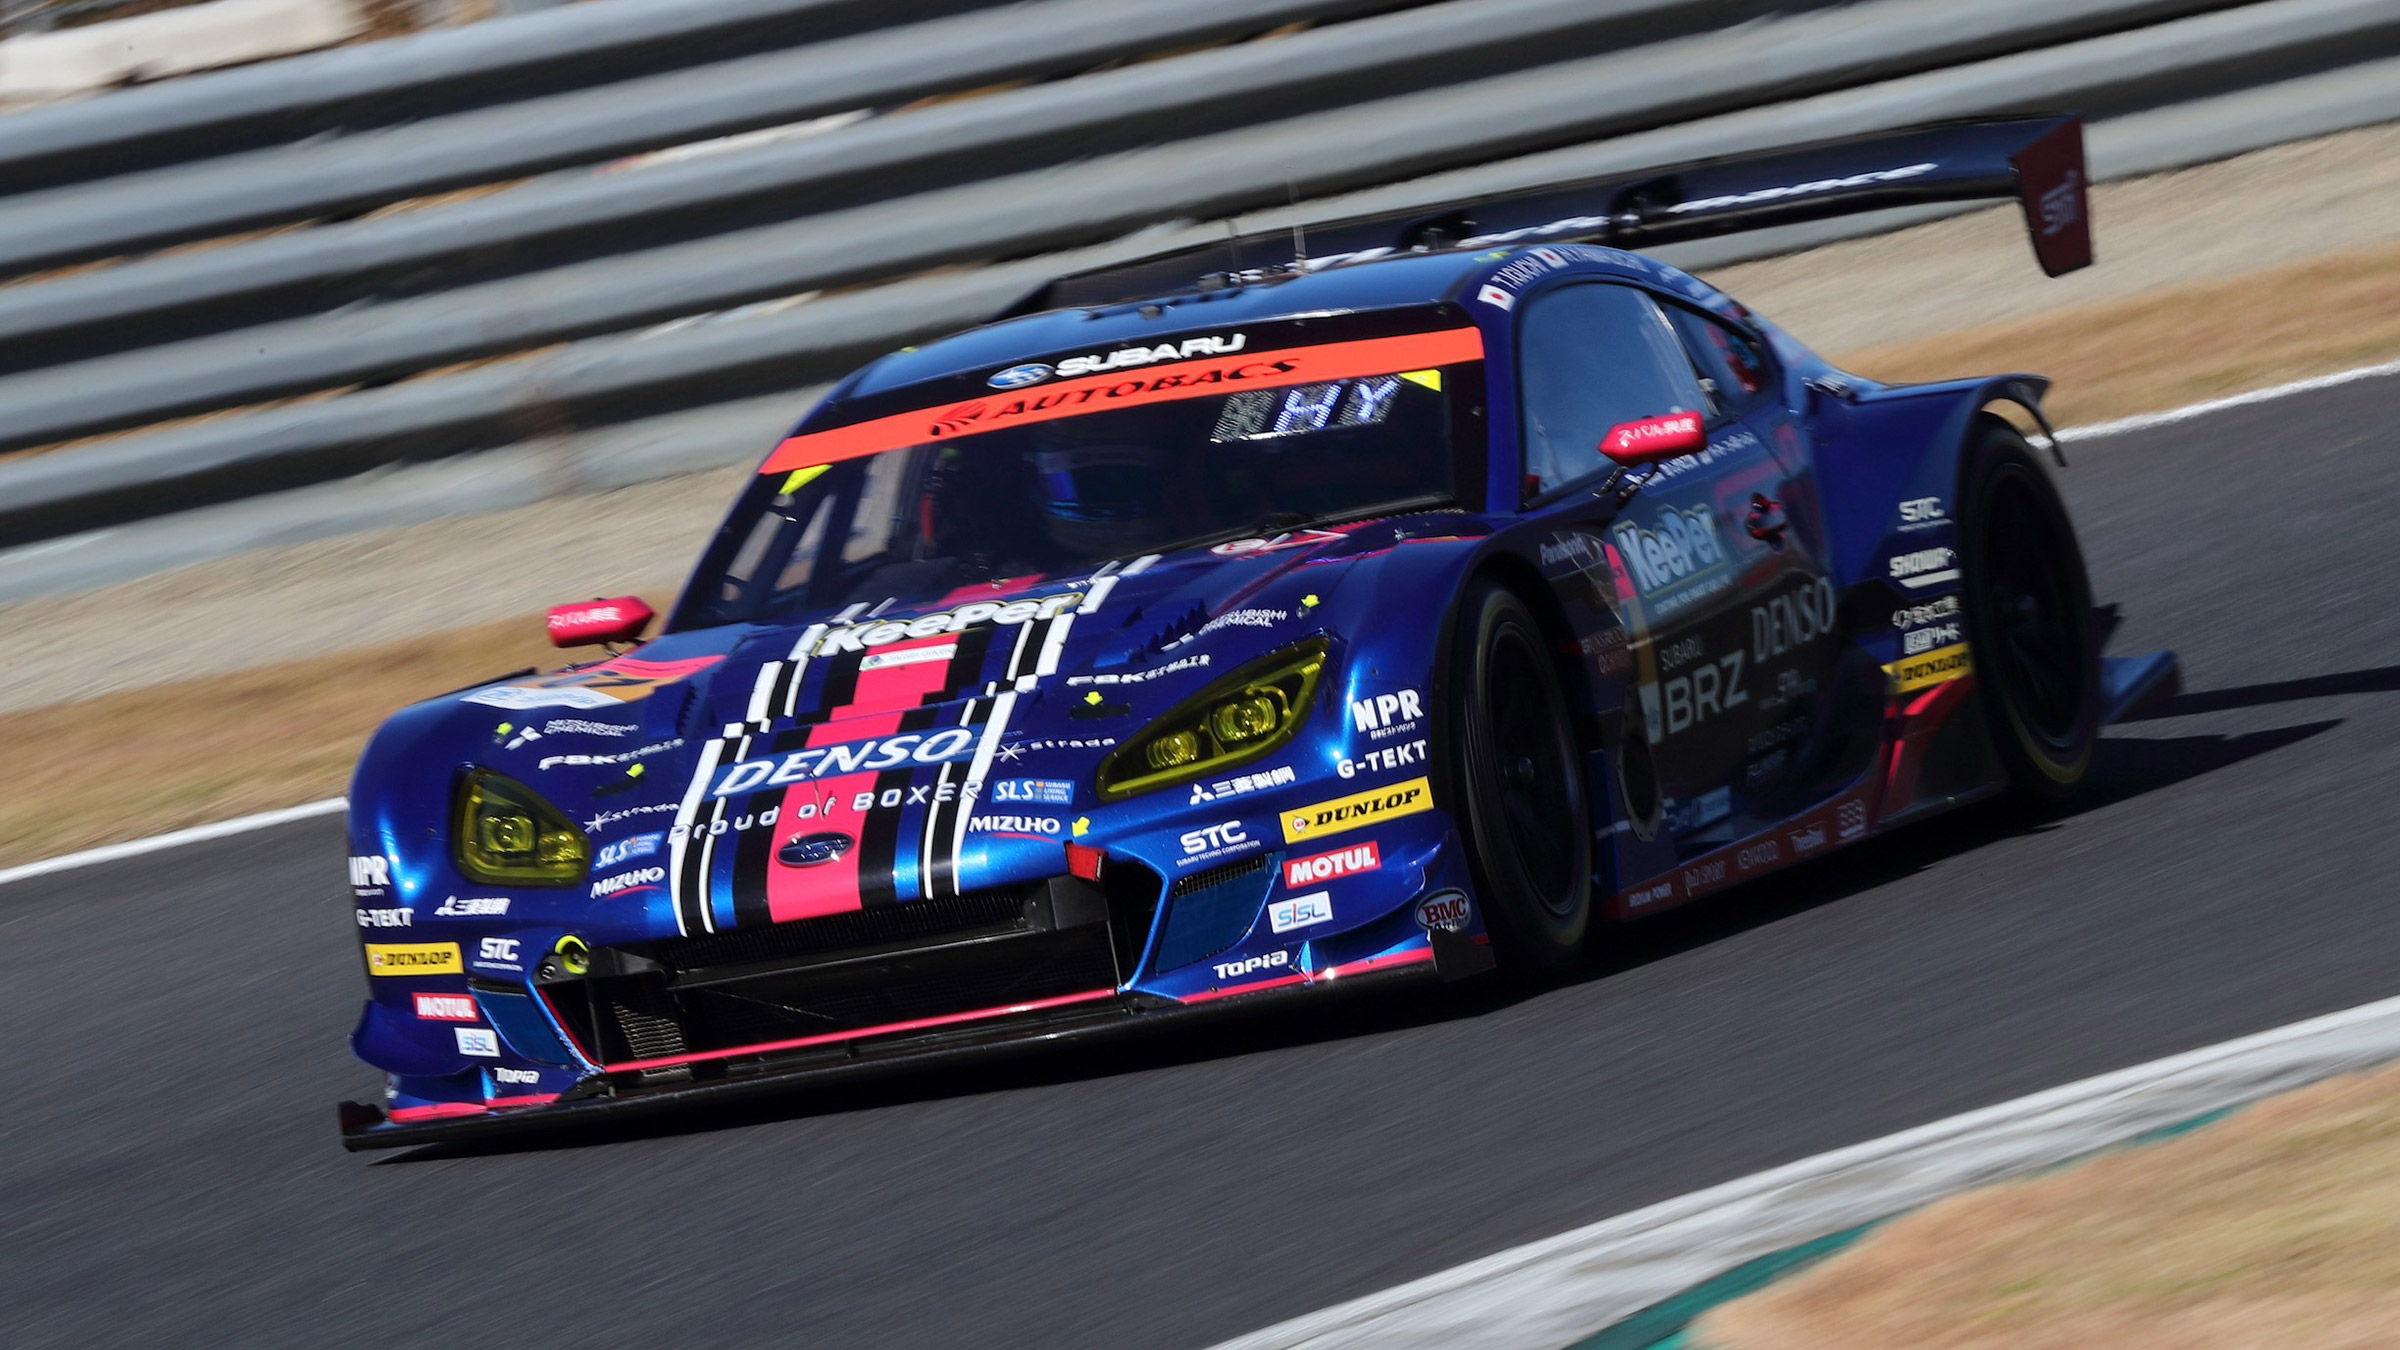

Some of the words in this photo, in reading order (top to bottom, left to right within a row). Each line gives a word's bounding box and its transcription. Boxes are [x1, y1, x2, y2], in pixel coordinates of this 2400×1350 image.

[1055, 333, 1246, 377] SUBARU
[995, 358, 1303, 416] AUTOBACS
[814, 593, 1083, 657] KeePer
[1751, 576, 1837, 664] DENSO
[1351, 689, 1424, 733] NPR
[1664, 649, 1750, 736] BRZ
[713, 729, 974, 796] DENSO
[1336, 740, 1427, 779] G-TEKT
[995, 780, 1036, 802] SLS
[1314, 788, 1422, 826] DUNLOP
[668, 805, 780, 845] Proud
[797, 796, 836, 820] of
[852, 780, 985, 812] BOXER
[969, 816, 1060, 836] MIZUHO
[596, 840, 630, 869] SLS
[1179, 820, 1248, 855] STC
[590, 867, 666, 900] MIZUHO
[1290, 847, 1376, 884] MOTUL
[357, 908, 414, 928] G-TEKT
[1423, 897, 1467, 924] BMC
[386, 952, 452, 966] DUNLOP
[480, 937, 521, 962] STC
[416, 997, 476, 1018] MOTUL
